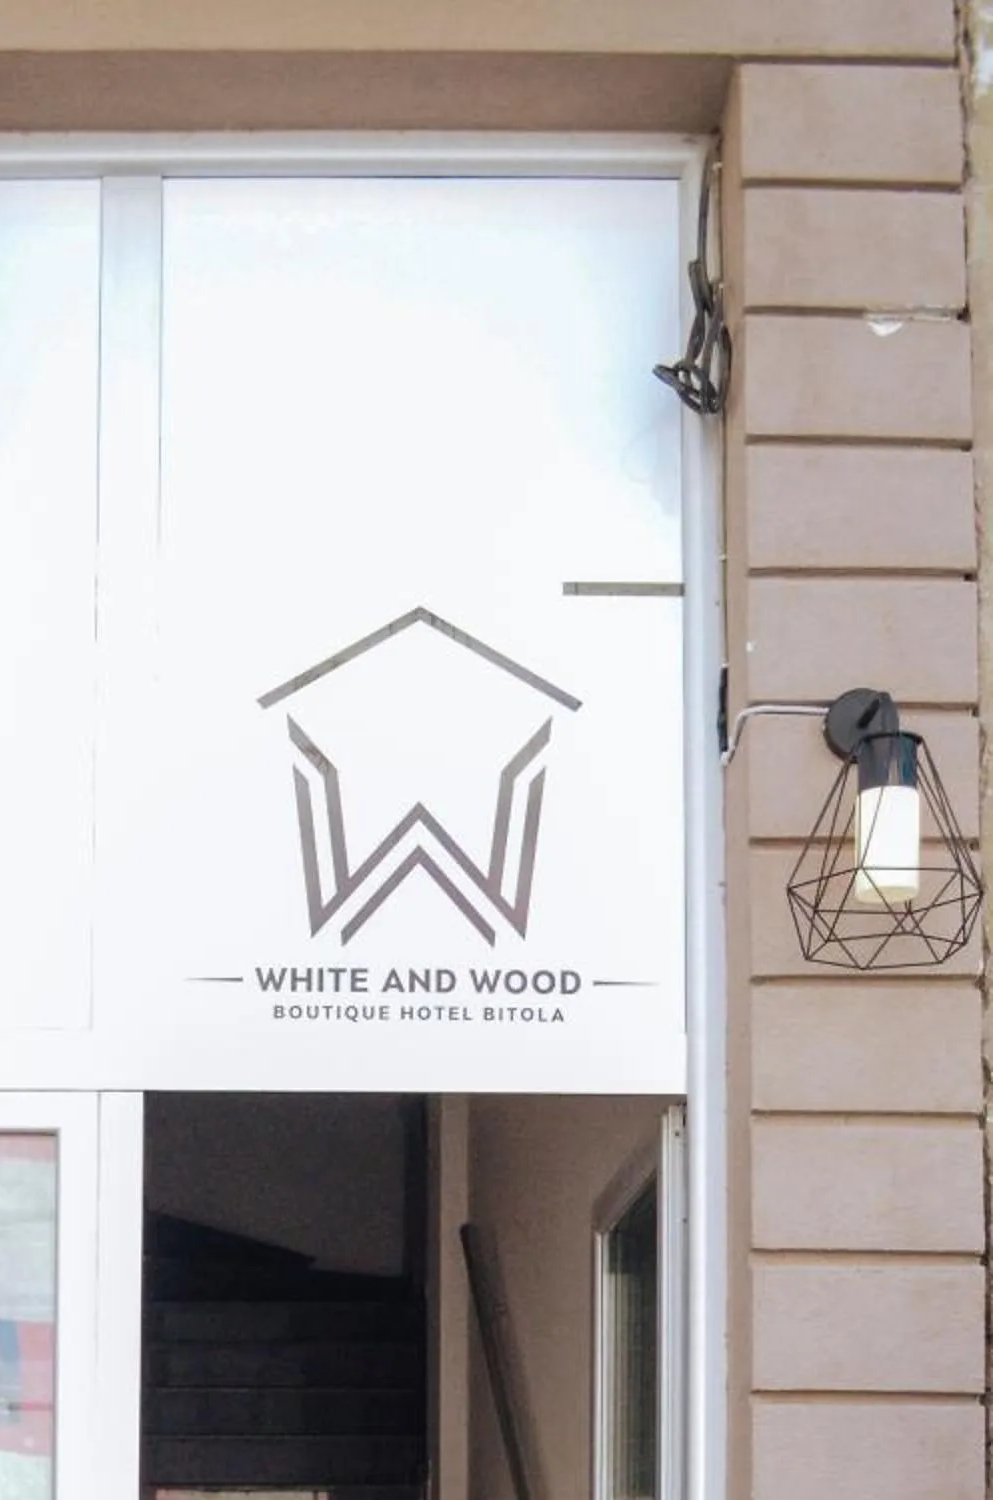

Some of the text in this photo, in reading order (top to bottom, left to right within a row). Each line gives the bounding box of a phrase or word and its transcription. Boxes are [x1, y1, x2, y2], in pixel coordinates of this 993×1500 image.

[254, 966, 582, 995] WHITE AND WOOD
[272, 1004, 565, 1023] BOUTIQUE HOTEL BITOLA
